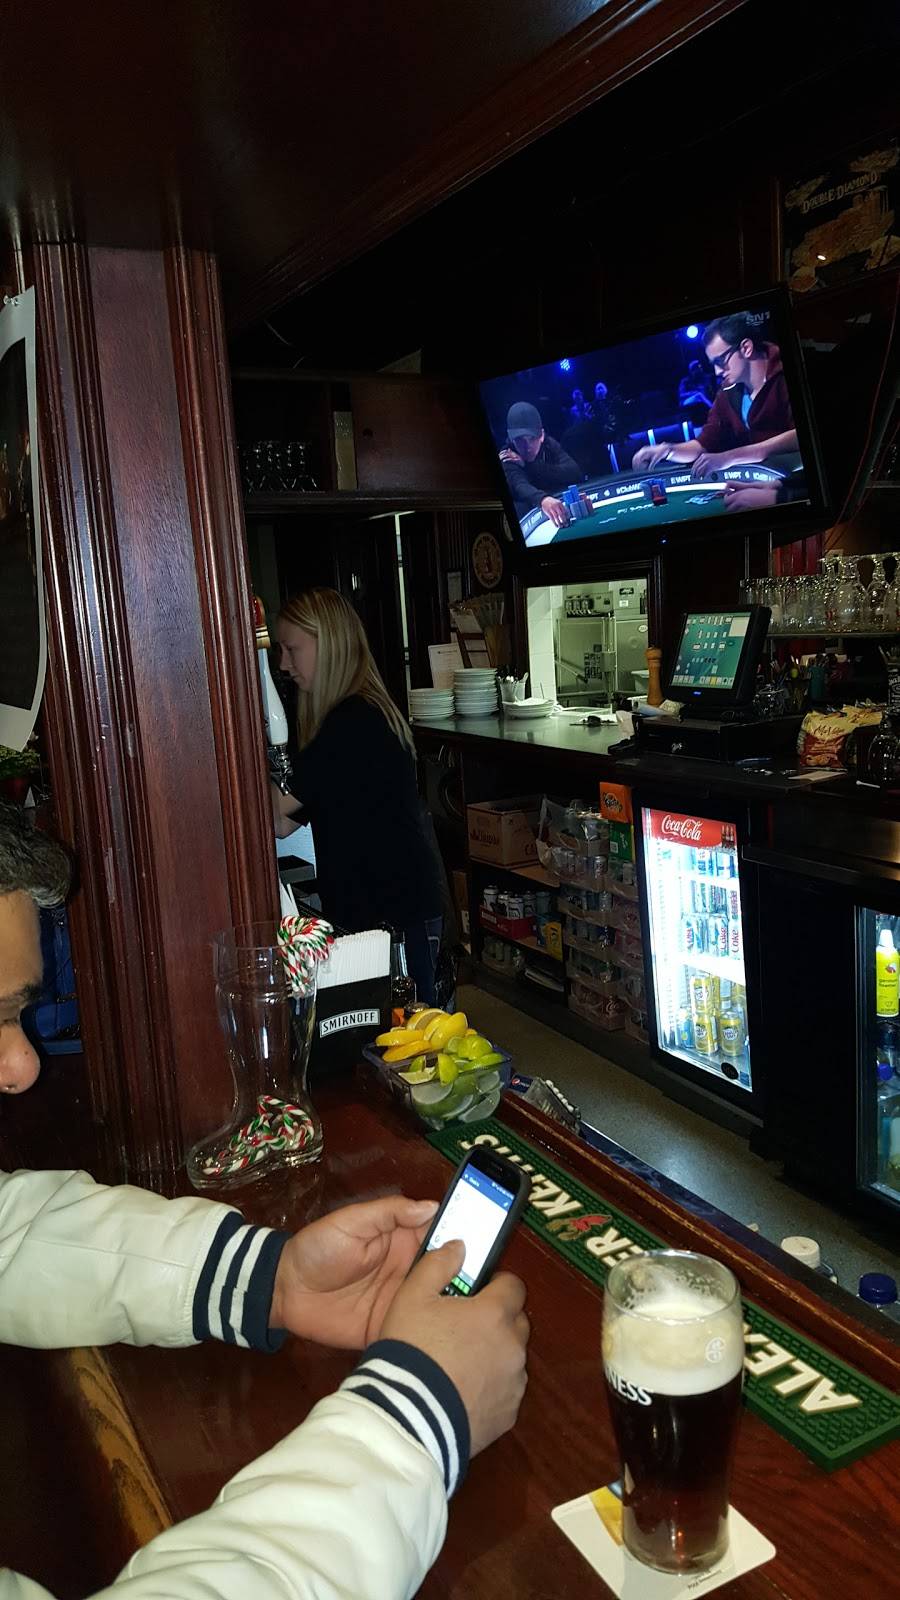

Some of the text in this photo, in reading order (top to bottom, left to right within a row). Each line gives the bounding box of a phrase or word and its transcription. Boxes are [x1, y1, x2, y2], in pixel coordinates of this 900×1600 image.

[801, 171, 879, 214] DOUBLE DIAMOND
[661, 814, 703, 841] Coca-Cola
[730, 929, 740, 953] Coke
[322, 1011, 376, 1034] SMIRNOFF
[604, 1366, 655, 1407] NESS
